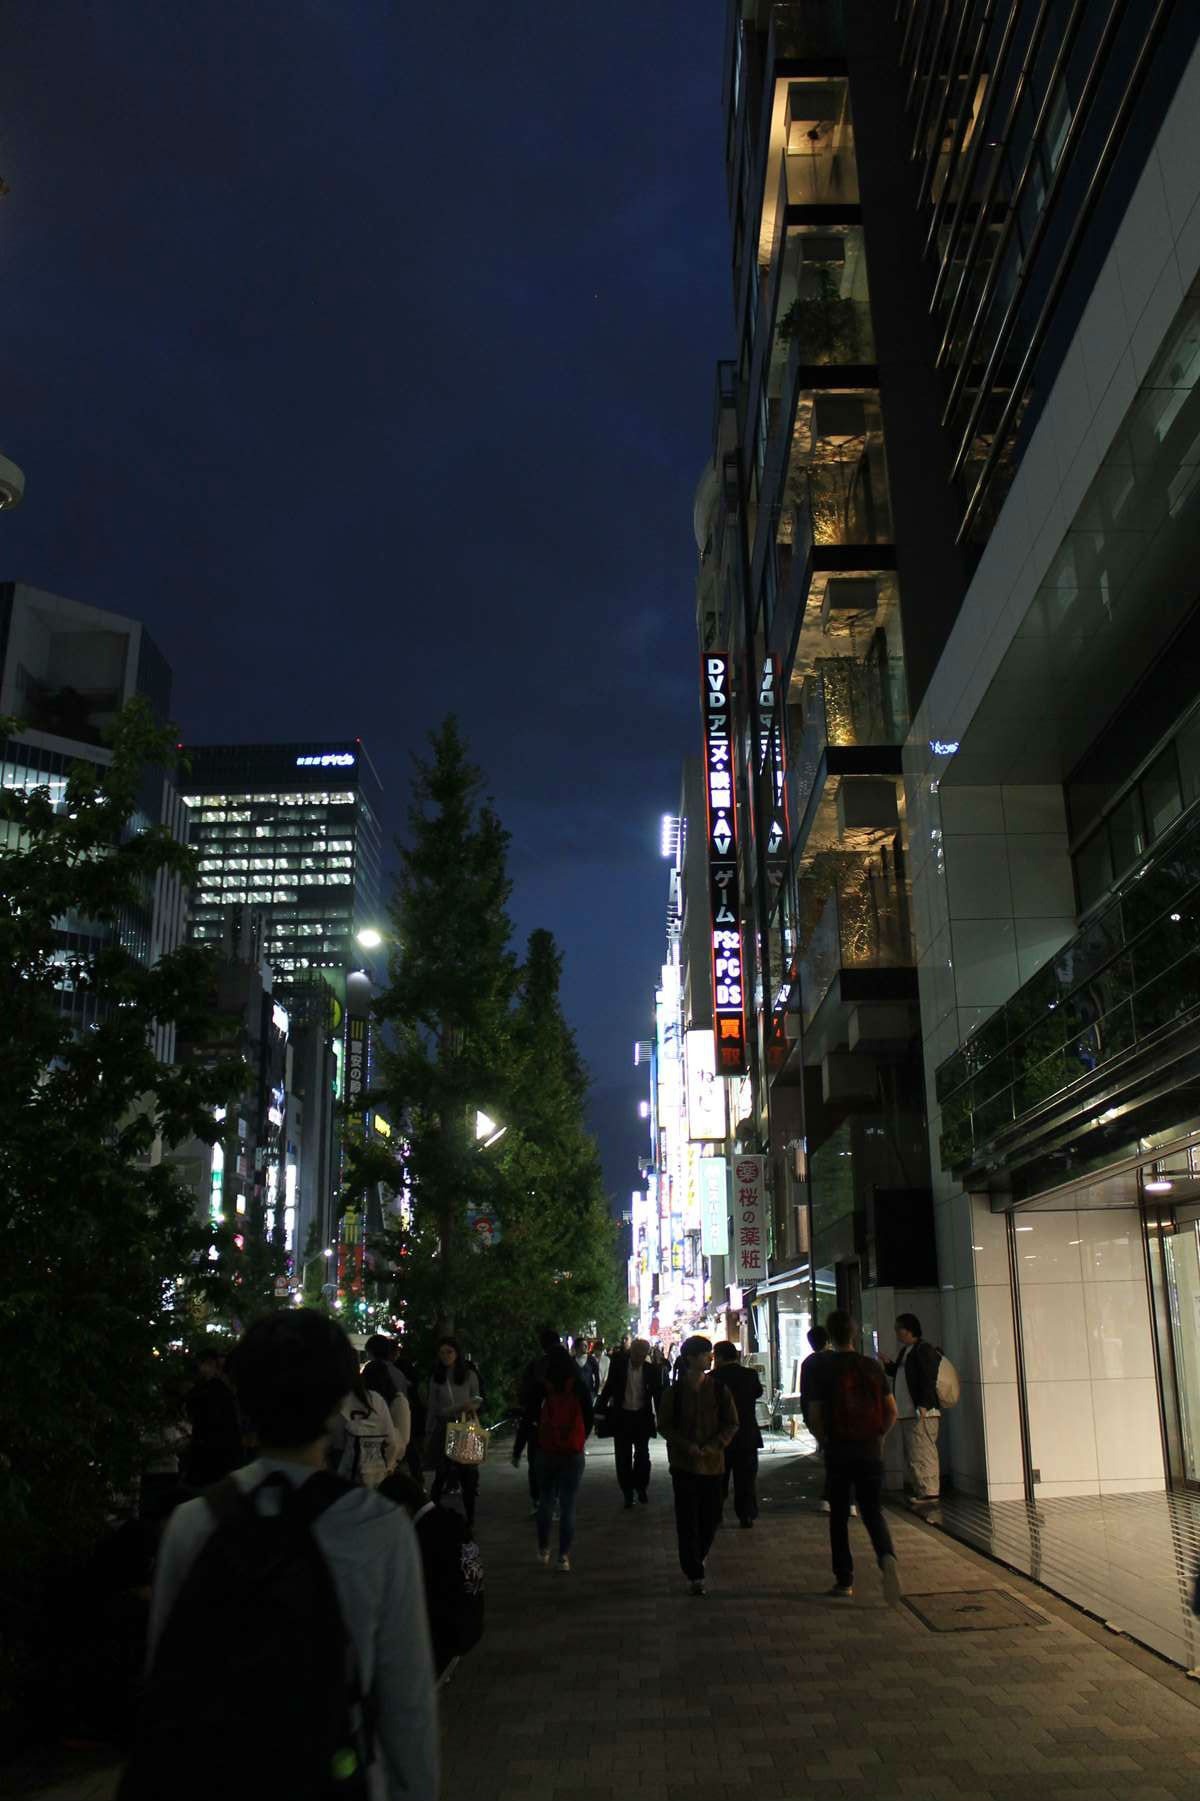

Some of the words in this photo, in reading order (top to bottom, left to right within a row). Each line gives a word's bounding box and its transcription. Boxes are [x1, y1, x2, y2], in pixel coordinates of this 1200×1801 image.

[707, 658, 727, 708] DVD
[714, 870, 735, 923] ゲーム
